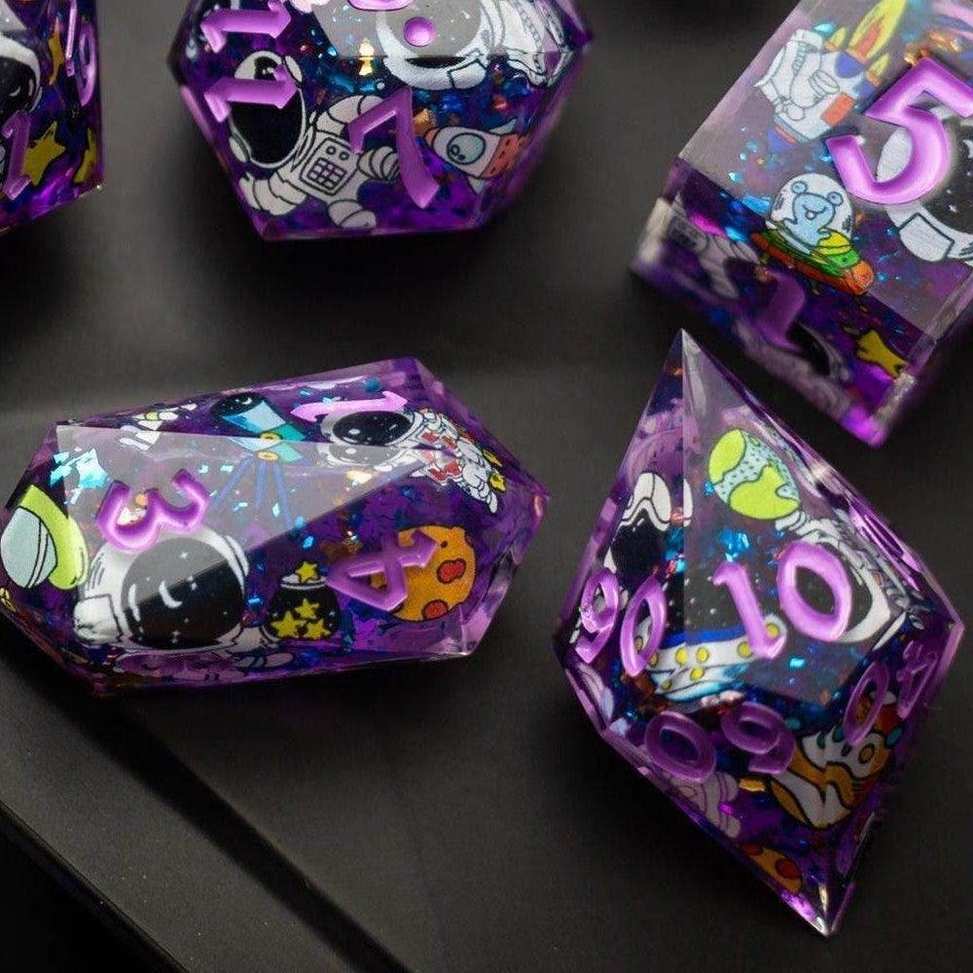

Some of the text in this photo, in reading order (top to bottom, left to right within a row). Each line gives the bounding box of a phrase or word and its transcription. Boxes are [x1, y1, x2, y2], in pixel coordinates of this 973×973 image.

[347, 88, 440, 208] 7
[826, 56, 973, 205] 5
[96, 468, 212, 554] 3
[328, 531, 442, 611] 4
[574, 567, 667, 677] 90
[713, 541, 853, 659] 10
